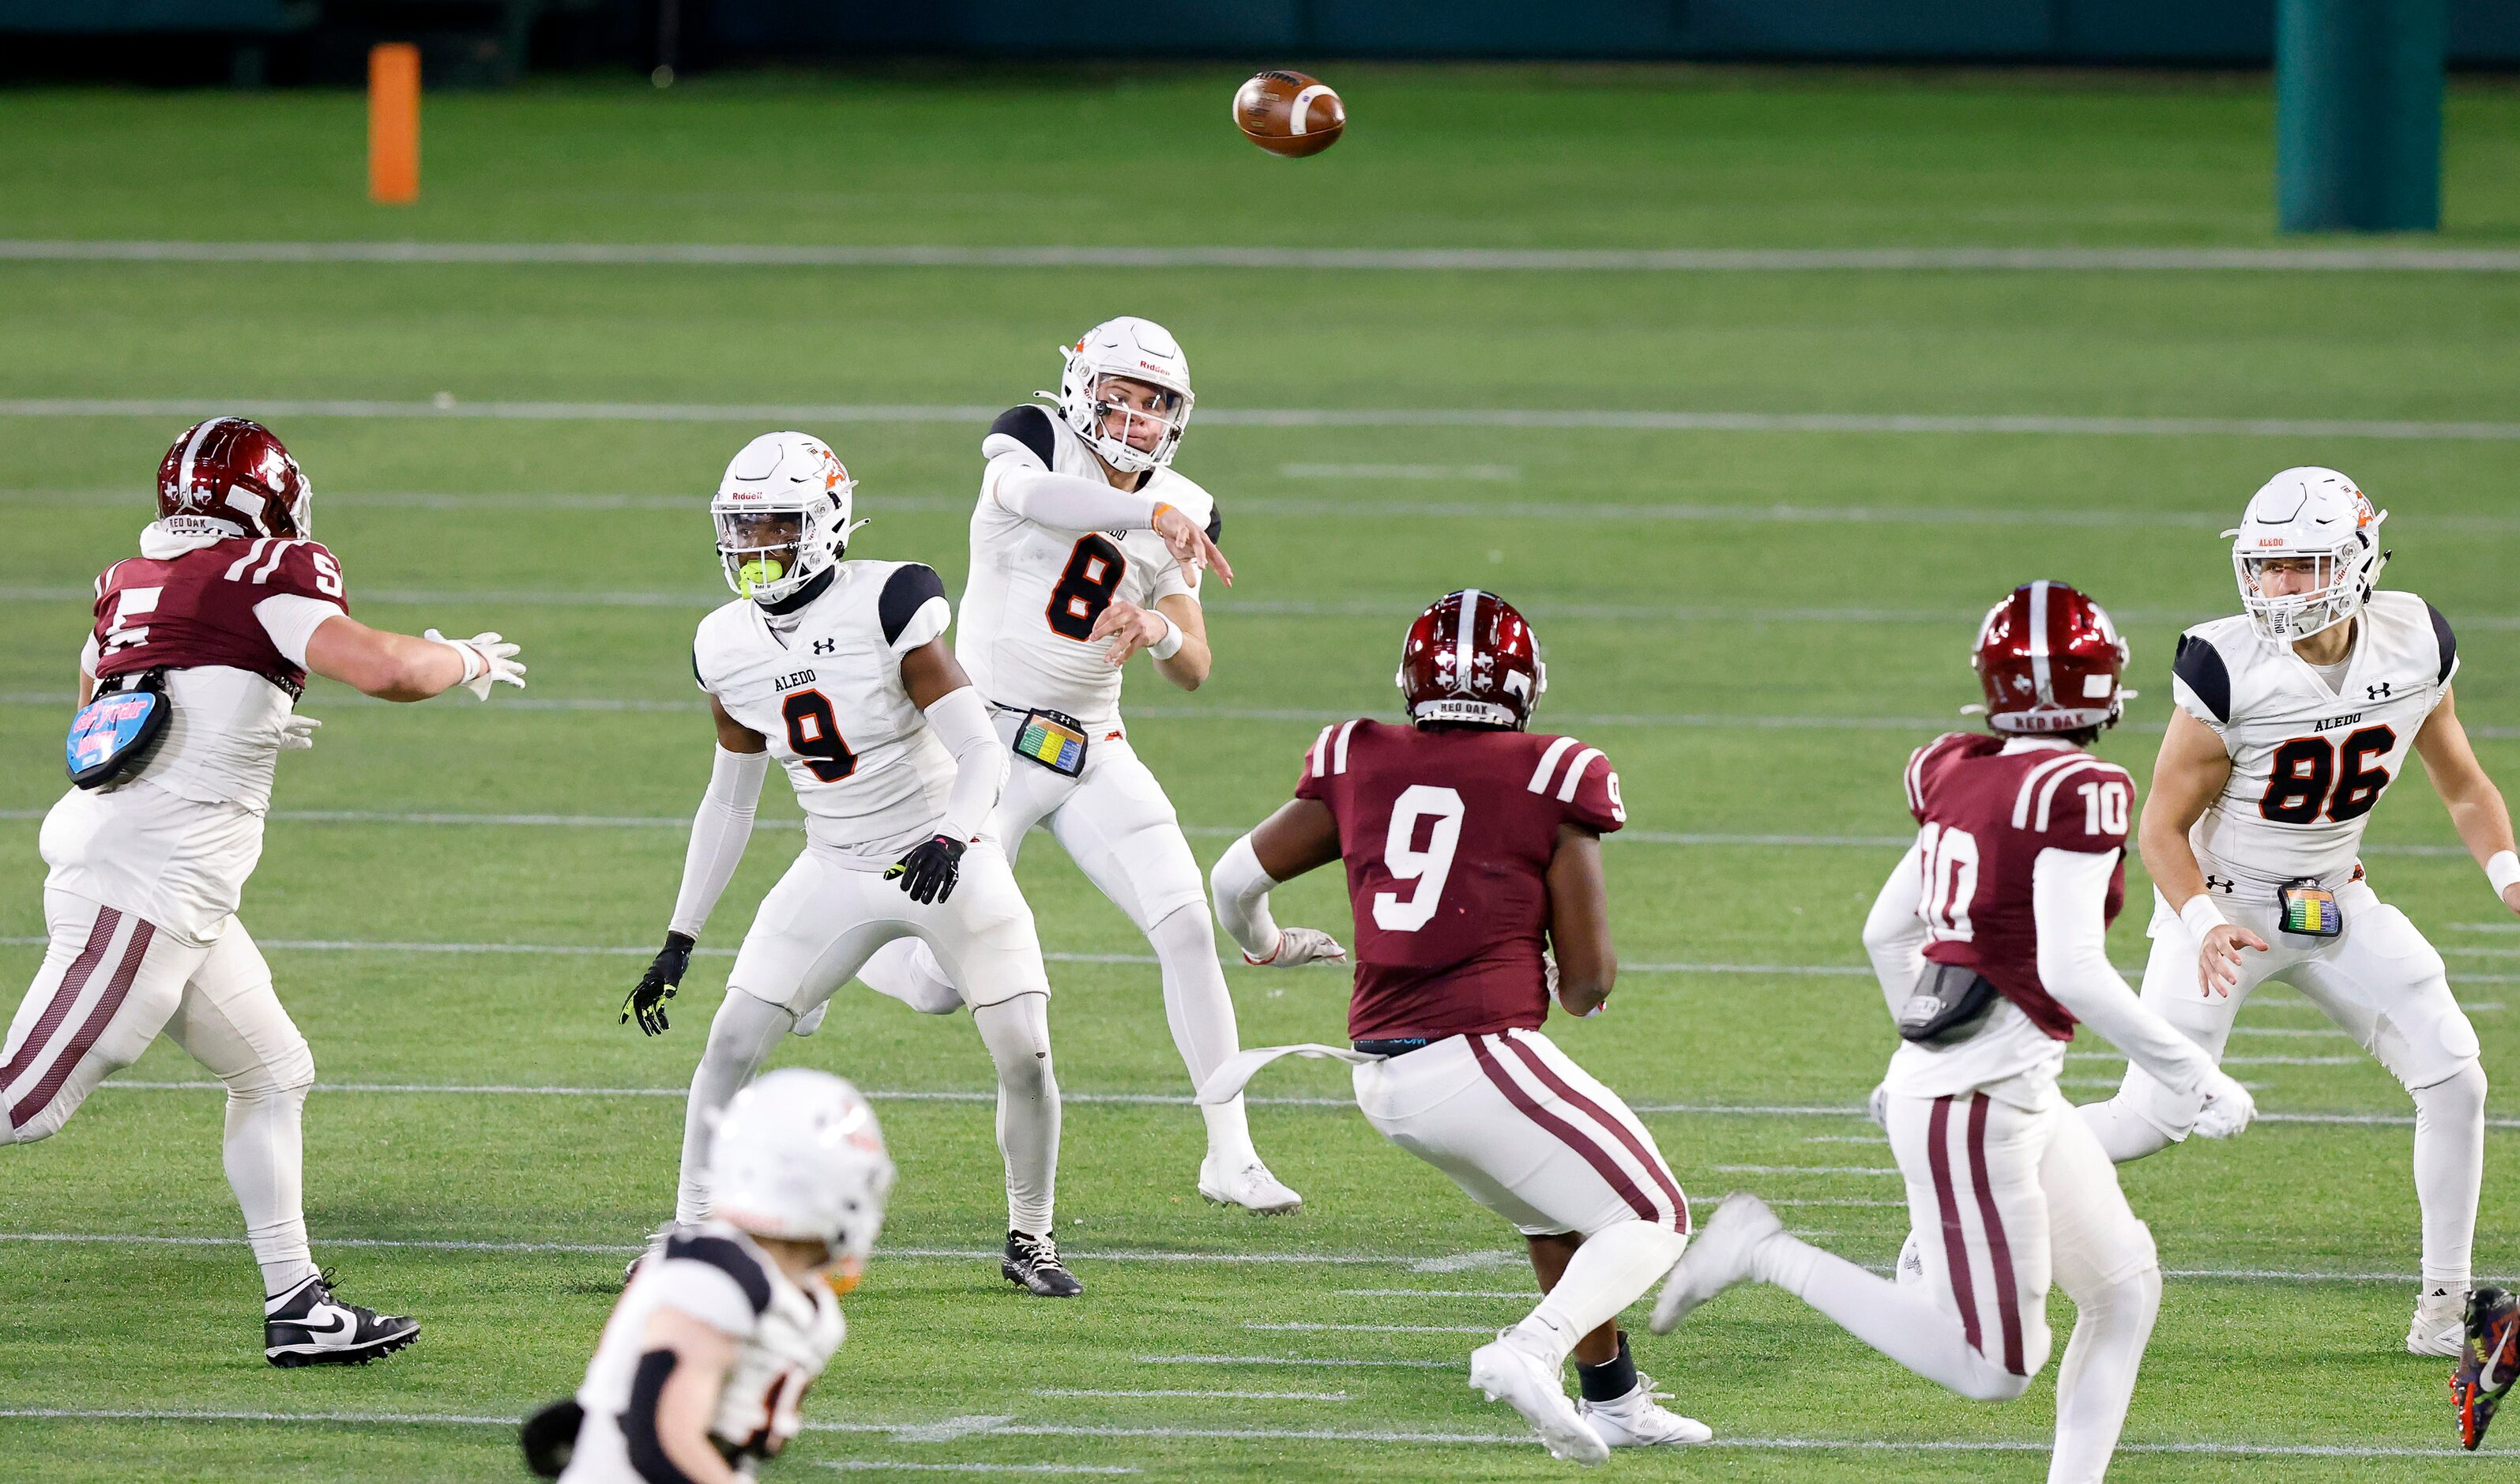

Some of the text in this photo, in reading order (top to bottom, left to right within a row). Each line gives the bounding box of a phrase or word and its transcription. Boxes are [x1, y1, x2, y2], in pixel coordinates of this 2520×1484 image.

[732, 492, 762, 500] Riddell
[170, 518, 206, 529] RED OAK
[2259, 538, 2284, 547] ALEDO
[313, 552, 343, 598] 5
[1045, 531, 1127, 642] 8
[775, 669, 817, 692] ALEDO
[1441, 703, 1488, 715] RED OAK
[2014, 712, 2085, 730] RED OAK
[2314, 712, 2362, 733] ALEDO
[781, 687, 859, 783] 9
[1606, 771, 1627, 823] 9
[2258, 724, 2398, 825] 86
[2077, 782, 2129, 835] 10
[1372, 784, 1466, 932] 9
[1917, 820, 1980, 943] 10
